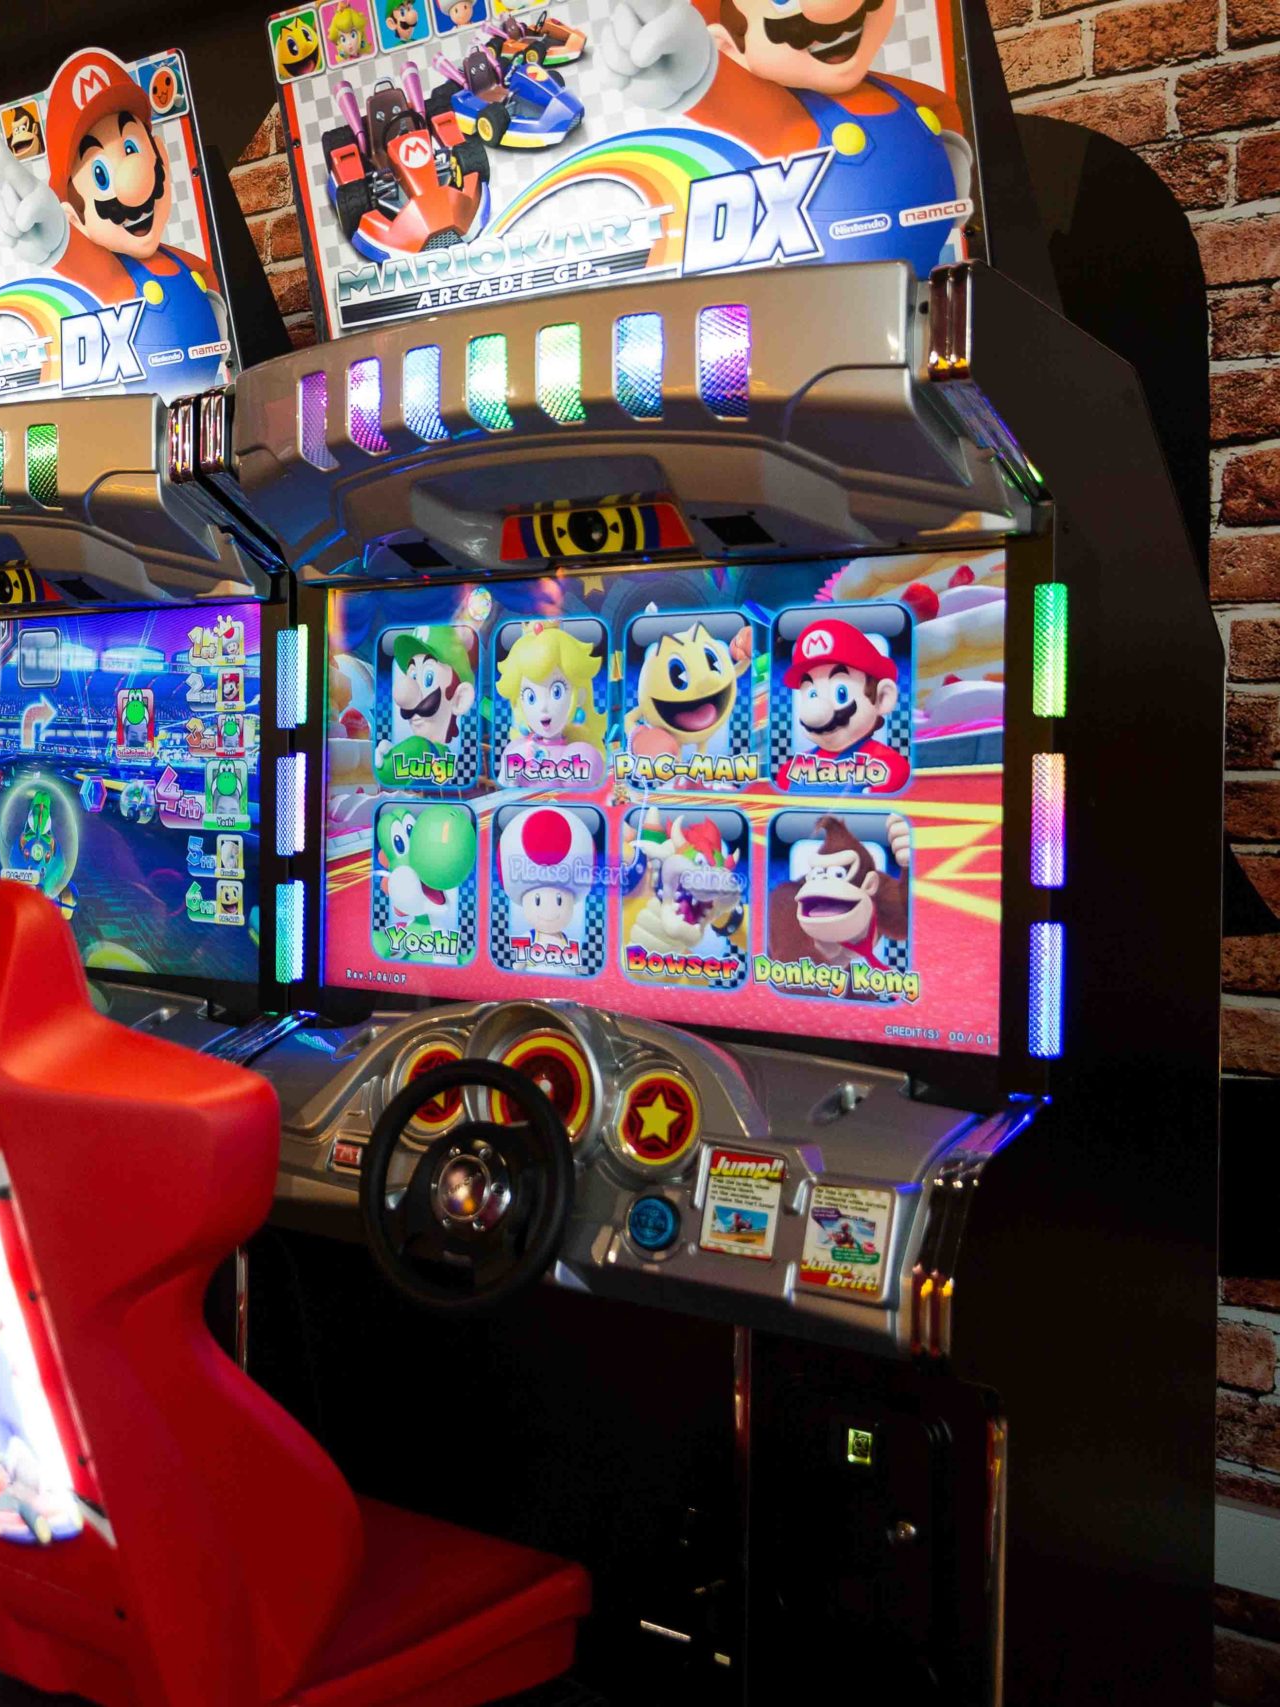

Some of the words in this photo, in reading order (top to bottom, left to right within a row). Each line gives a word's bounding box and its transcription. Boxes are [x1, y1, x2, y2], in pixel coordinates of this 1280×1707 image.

[682, 146, 836, 276] DX
[833, 216, 888, 236] Nintendo
[904, 202, 968, 223] namco
[416, 271, 535, 309] ARCADE
[61, 298, 148, 391] DX
[191, 343, 228, 357] namco
[392, 752, 457, 786] Luigi
[505, 752, 592, 784] Peach
[614, 751, 759, 785] PAC-MAN
[787, 751, 891, 788] Mario
[385, 922, 460, 957] Yoshi
[510, 936, 581, 969] Toad
[624, 944, 741, 980] Bowser
[753, 953, 847, 999] Donkey
[850, 963, 920, 1004] Kong
[884, 1024, 940, 1040] CREDIT(S)
[709, 1156, 784, 1180] Jump!!
